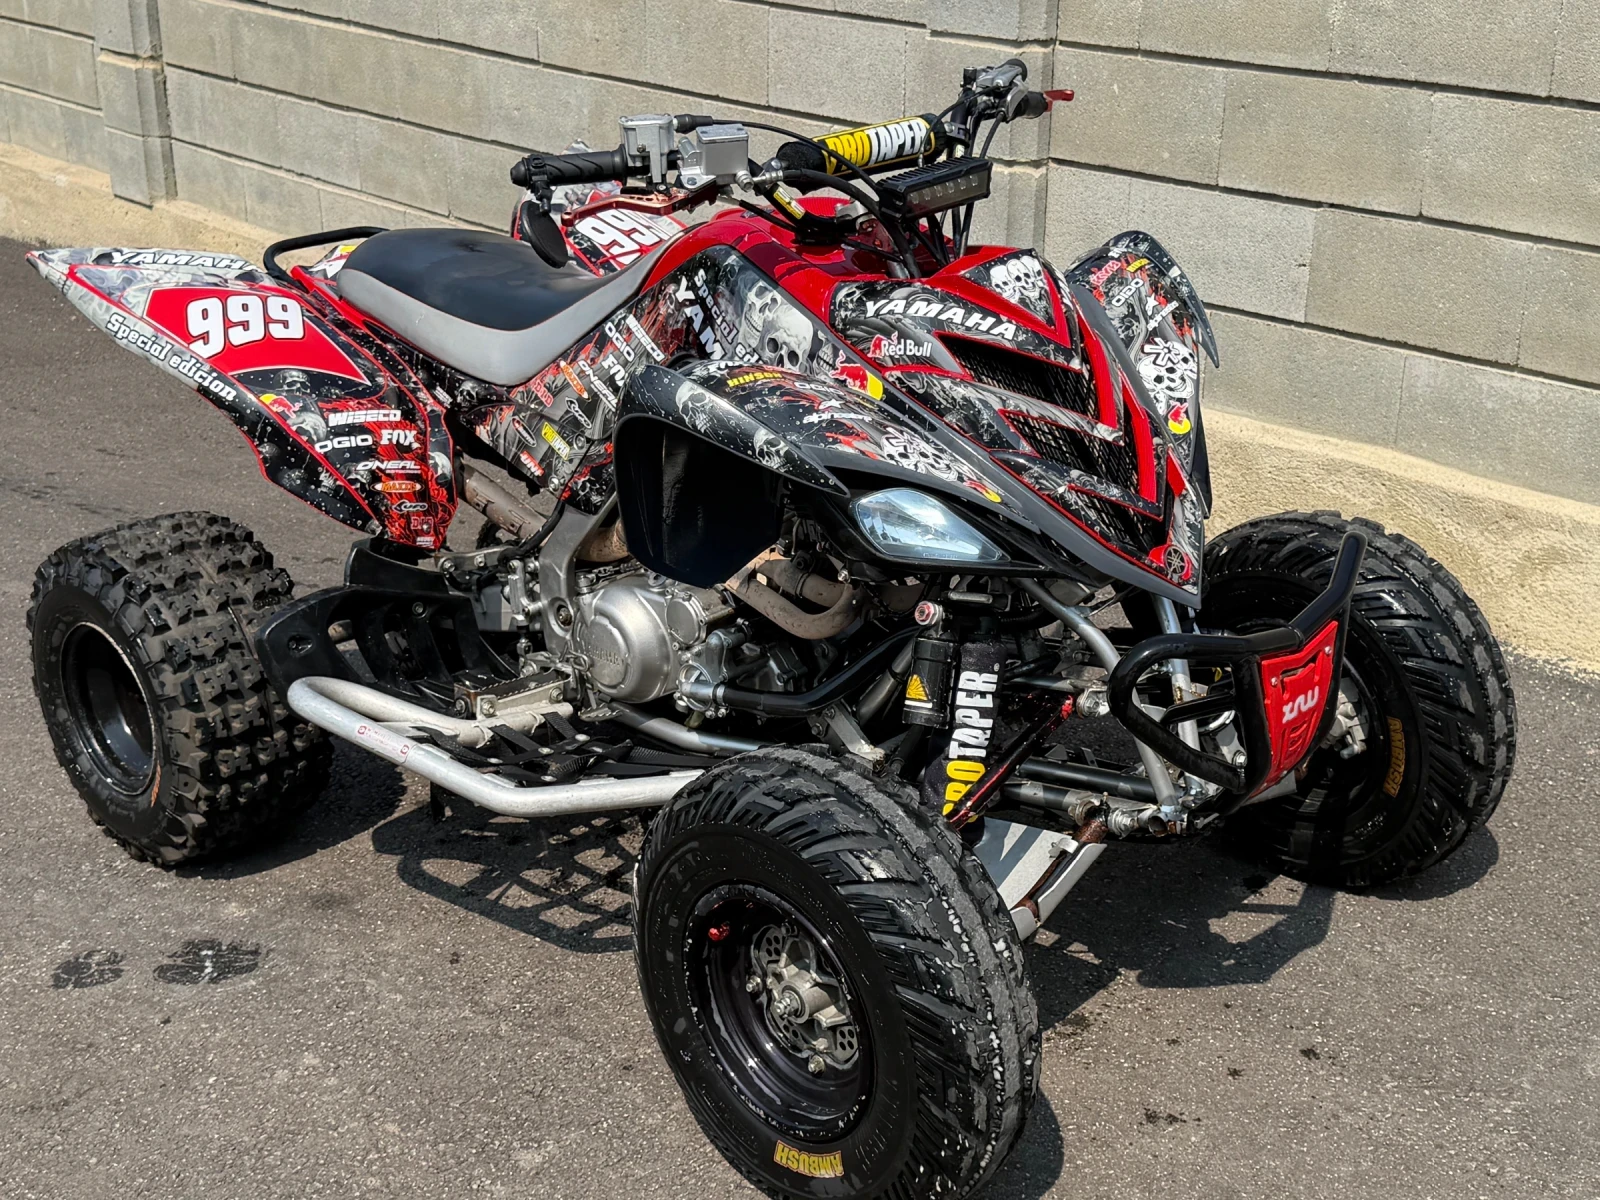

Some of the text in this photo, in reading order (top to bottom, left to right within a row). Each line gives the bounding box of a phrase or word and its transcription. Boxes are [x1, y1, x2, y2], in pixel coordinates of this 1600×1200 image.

[694, 268, 739, 345] Special
[865, 300, 1017, 340] YAMAHA
[186, 294, 305, 360] 999
[604, 321, 635, 362] OGIO
[106, 312, 238, 402] Special edicion
[881, 338, 932, 358] Red Bull
[314, 434, 373, 453] OGIO
[380, 429, 417, 446] FOX
[774, 1141, 844, 1177] AMBUSH
